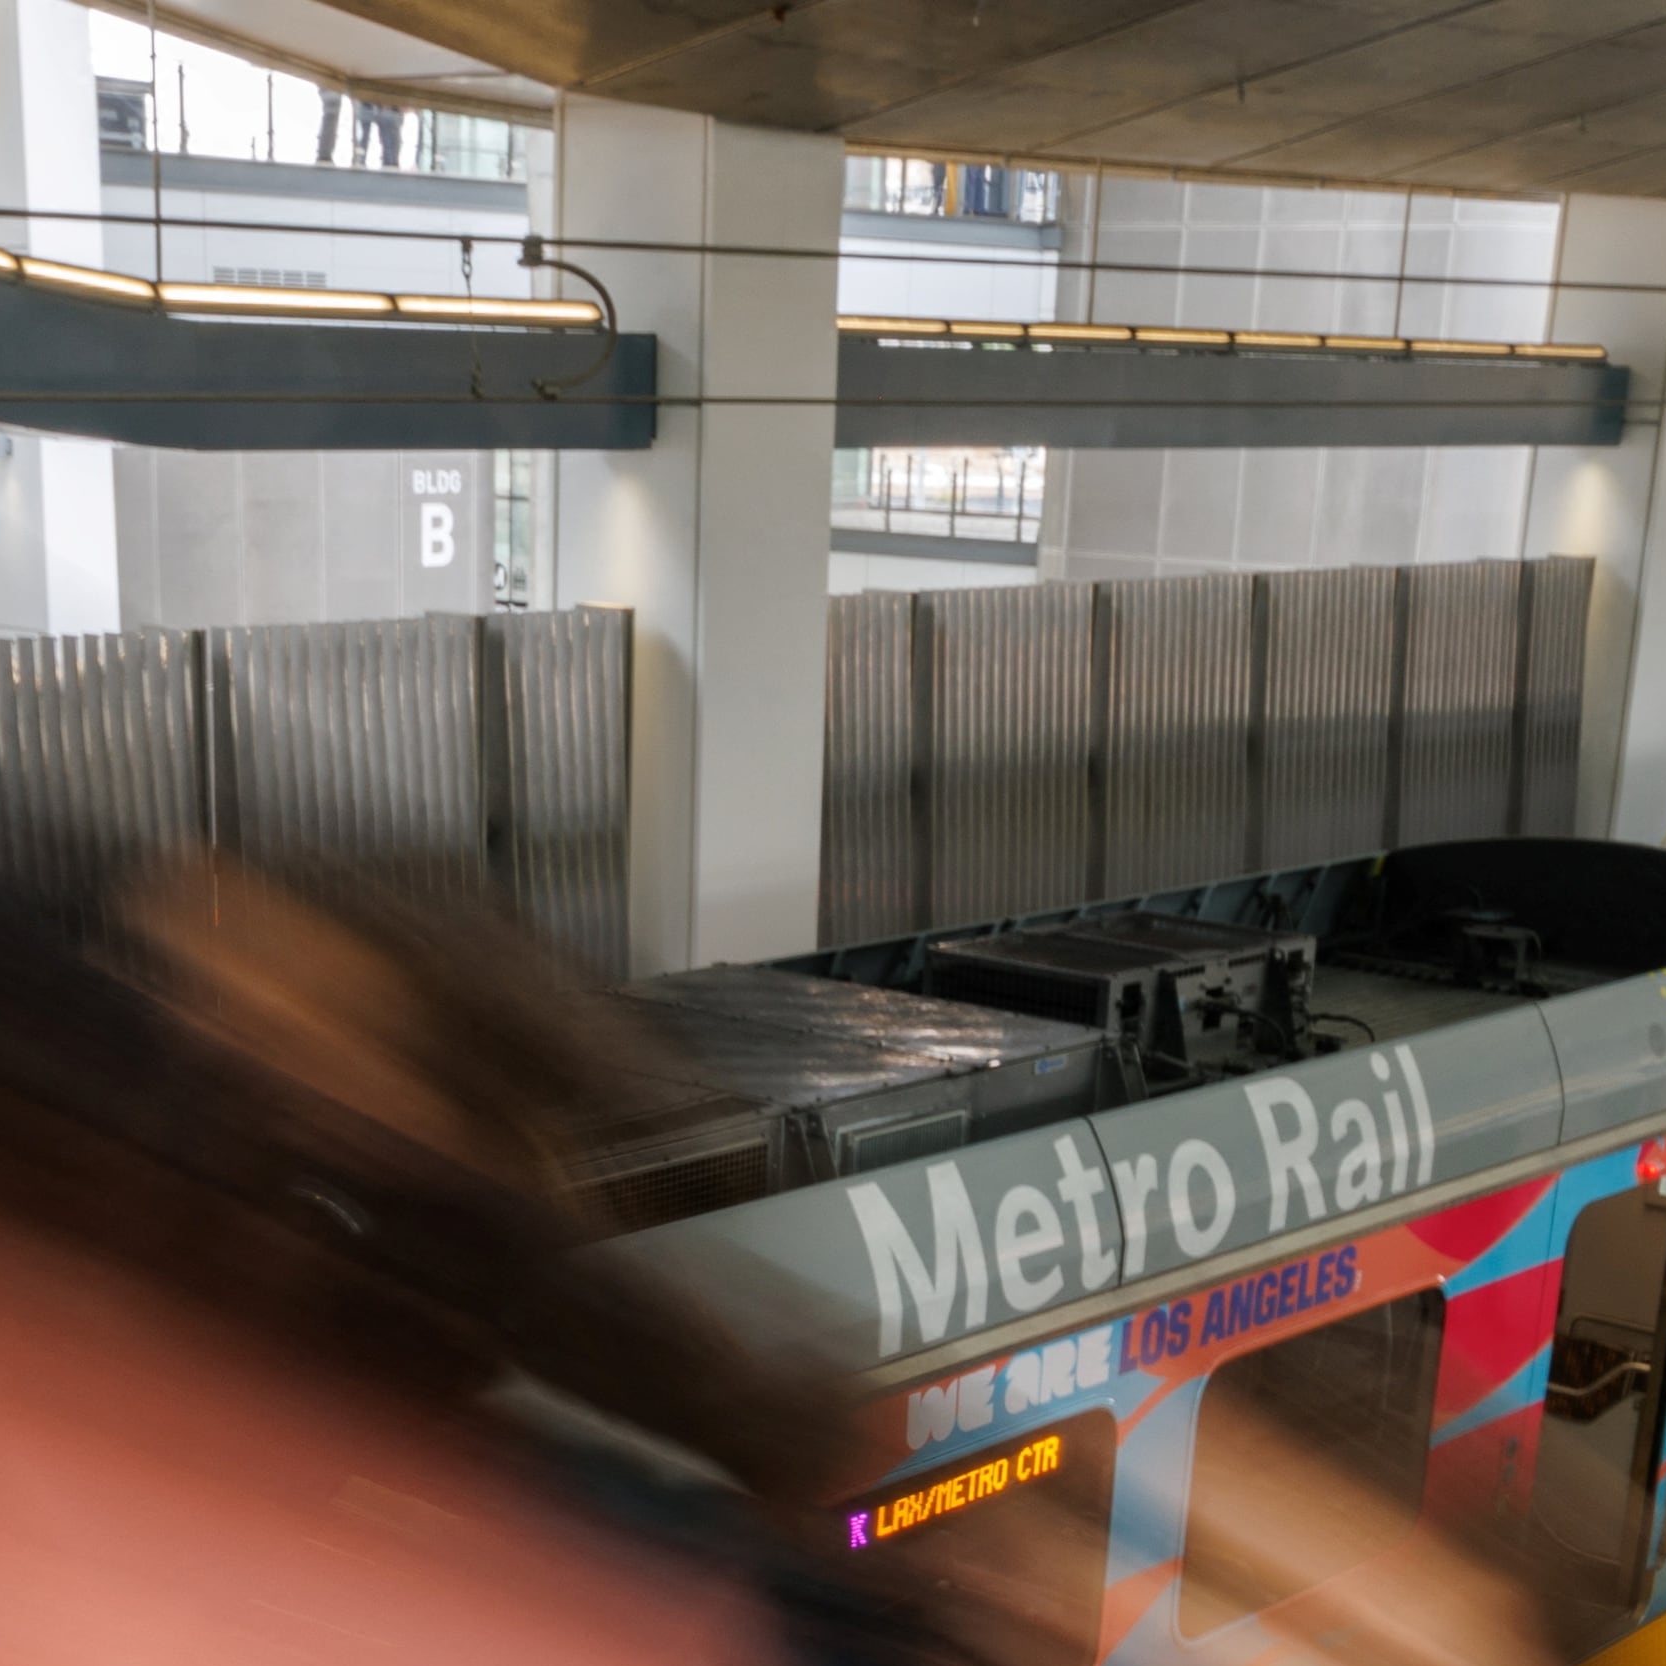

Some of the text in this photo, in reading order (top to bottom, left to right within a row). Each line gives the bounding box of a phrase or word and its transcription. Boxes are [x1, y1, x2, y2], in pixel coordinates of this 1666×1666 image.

[412, 469, 461, 493] BLDG
[421, 502, 455, 567] B
[847, 1044, 1436, 1358] Metro Rail
[906, 1245, 1357, 1450] WE ARE LOS ANGELES
[850, 1435, 1061, 1549] K LAX/METRO CTR
